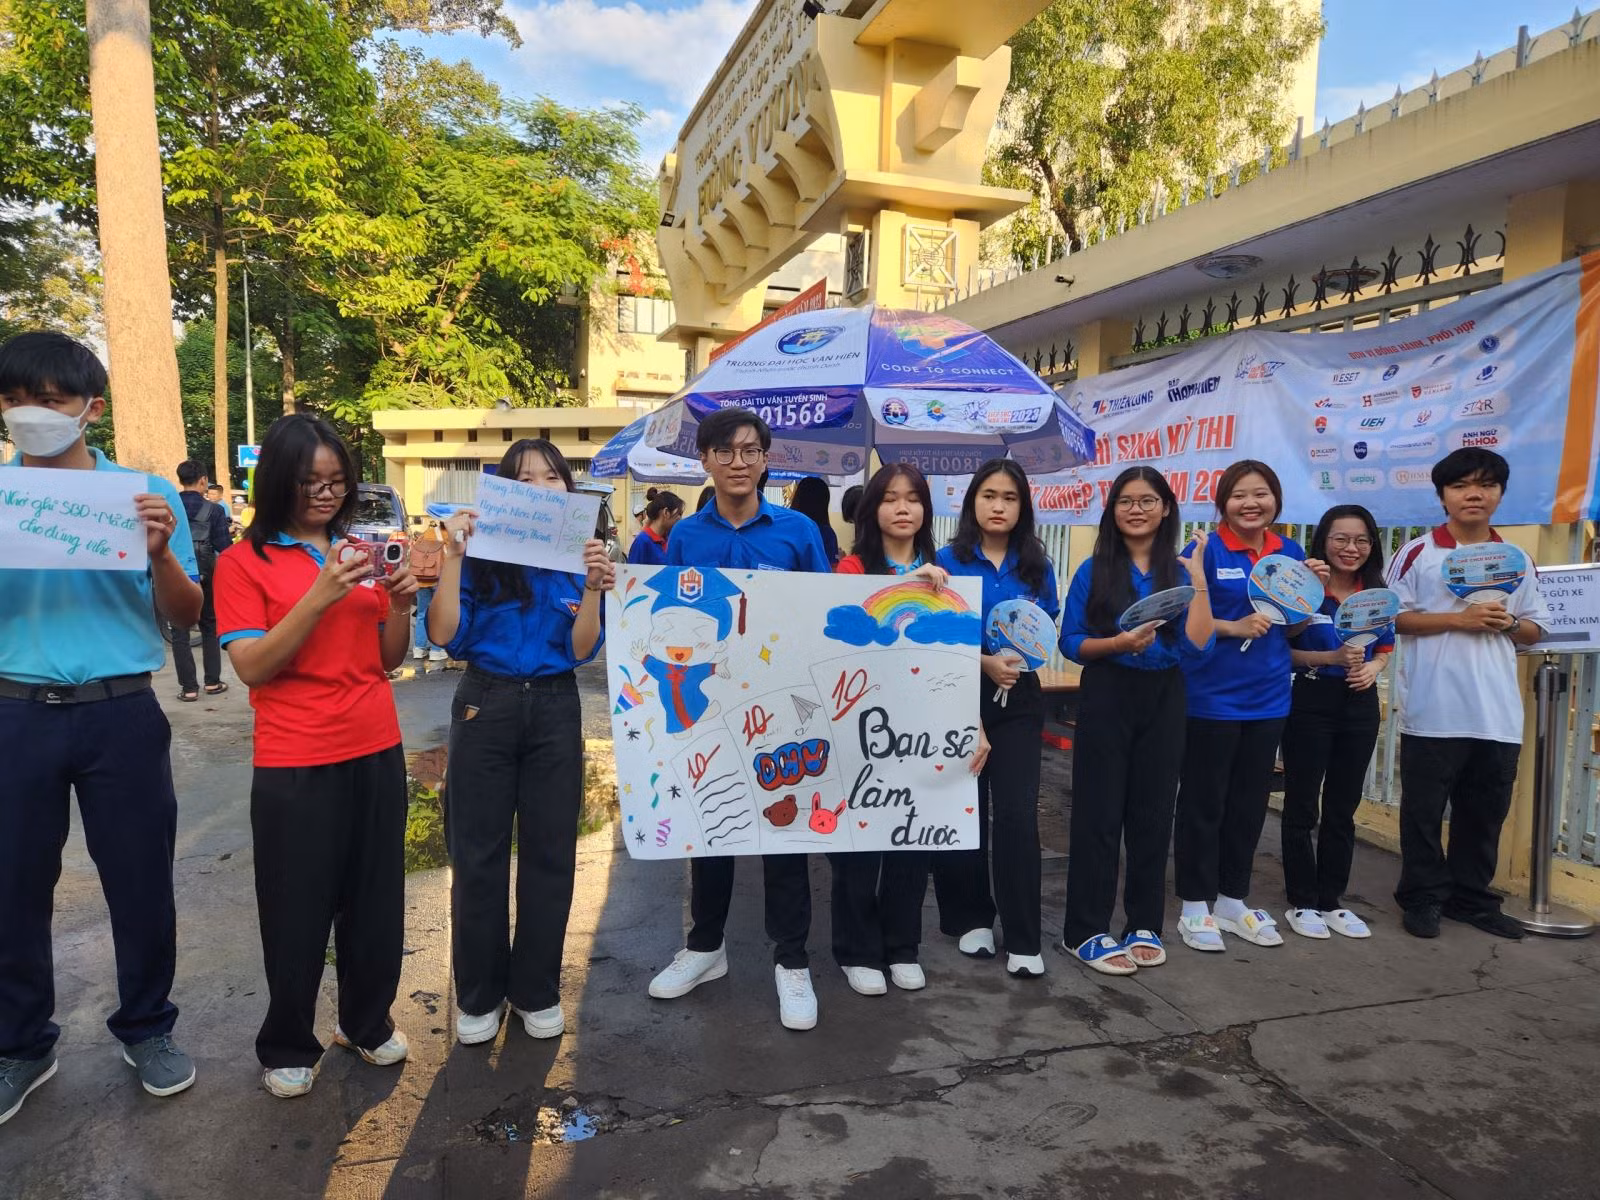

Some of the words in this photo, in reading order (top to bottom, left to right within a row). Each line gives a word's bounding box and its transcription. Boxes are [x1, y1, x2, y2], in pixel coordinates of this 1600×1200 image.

[880, 362, 920, 374] CODE
[926, 366, 945, 375] TO
[951, 367, 1015, 377] CONNECT
[1338, 371, 1361, 383] ESET
[809, 392, 829, 402] SINH
[1011, 407, 1040, 423] 2023
[1360, 417, 1386, 428] UEH
[1117, 428, 1163, 461] SINH
[1166, 415, 1195, 455] KỲ
[1196, 414, 1236, 450] THI
[1039, 479, 1093, 516] NGHIỆP
[59, 500, 91, 518] SBD
[1557, 575, 1575, 584] COI
[1576, 574, 1594, 583] THI
[1571, 588, 1584, 597] XE
[1557, 602, 1566, 611] 2
[1579, 616, 1599, 625] KIM
[858, 705, 938, 764] Bạn
[941, 726, 978, 759] sẽ
[847, 762, 914, 811] làm
